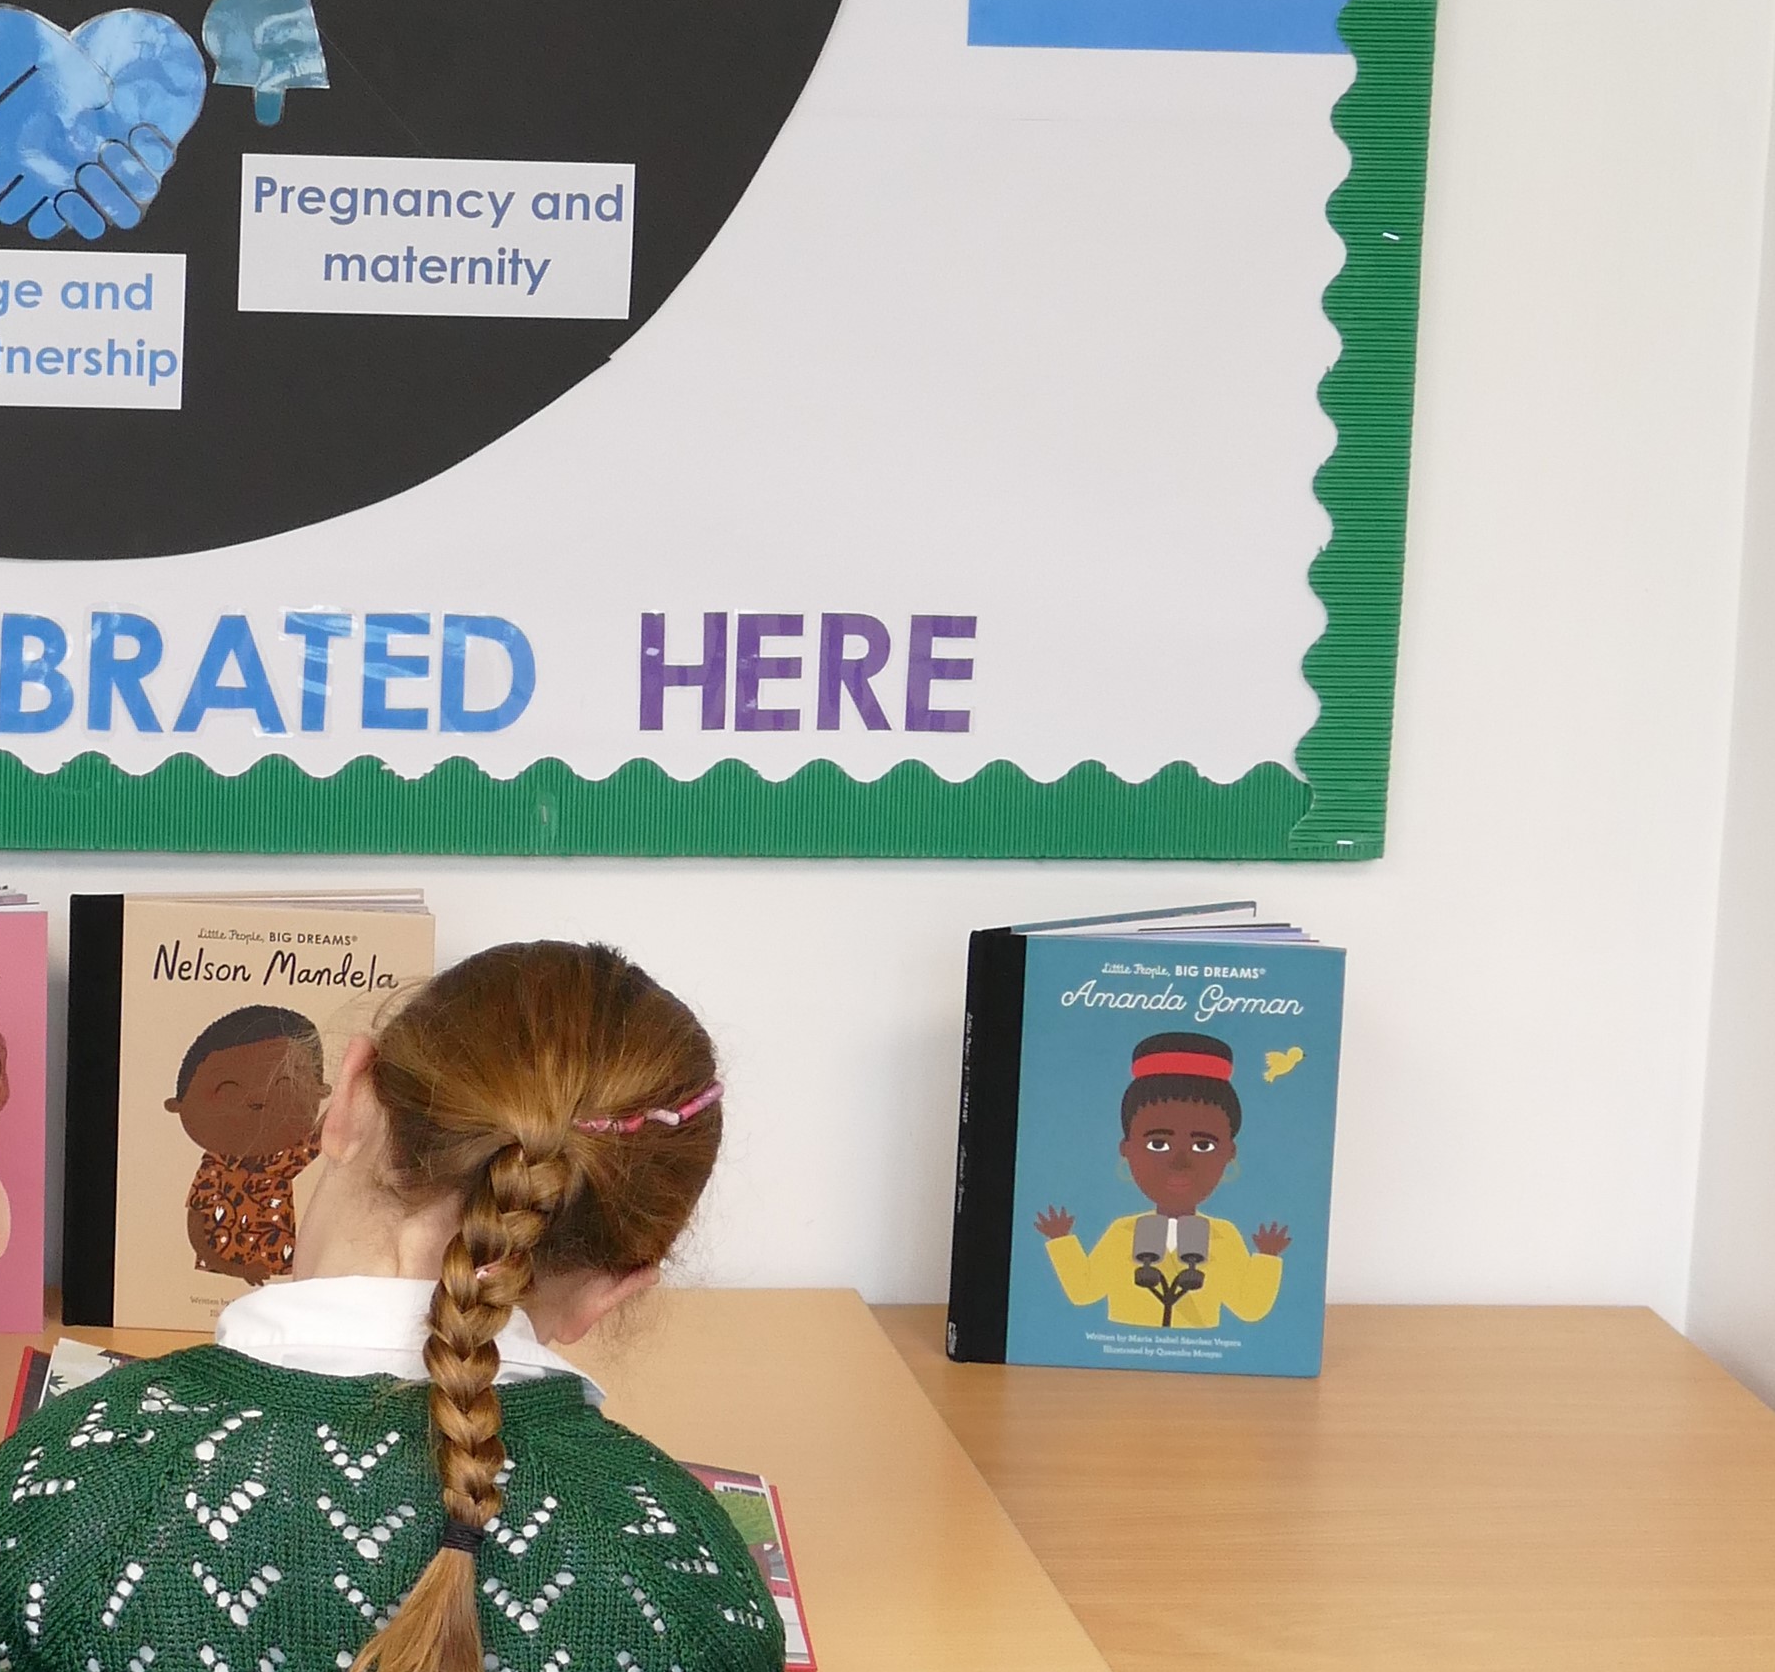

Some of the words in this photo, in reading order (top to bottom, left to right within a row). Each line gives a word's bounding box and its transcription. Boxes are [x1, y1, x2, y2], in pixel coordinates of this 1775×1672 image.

[252, 175, 516, 228] Pregnancy
[530, 181, 625, 222] and
[60, 272, 154, 312] and
[323, 246, 551, 296] maternity
[638, 610, 977, 734] HERE
[198, 928, 226, 940] Little
[229, 929, 265, 945] People,
[269, 932, 292, 943] BIG
[153, 940, 251, 981] Nelson
[263, 950, 399, 992] Mandela
[1101, 963, 1131, 974] Little
[1133, 963, 1171, 979] People,
[1175, 965, 1199, 977] BIG
[1061, 980, 1187, 1010] Amanda
[1195, 984, 1304, 1023] Gorman
